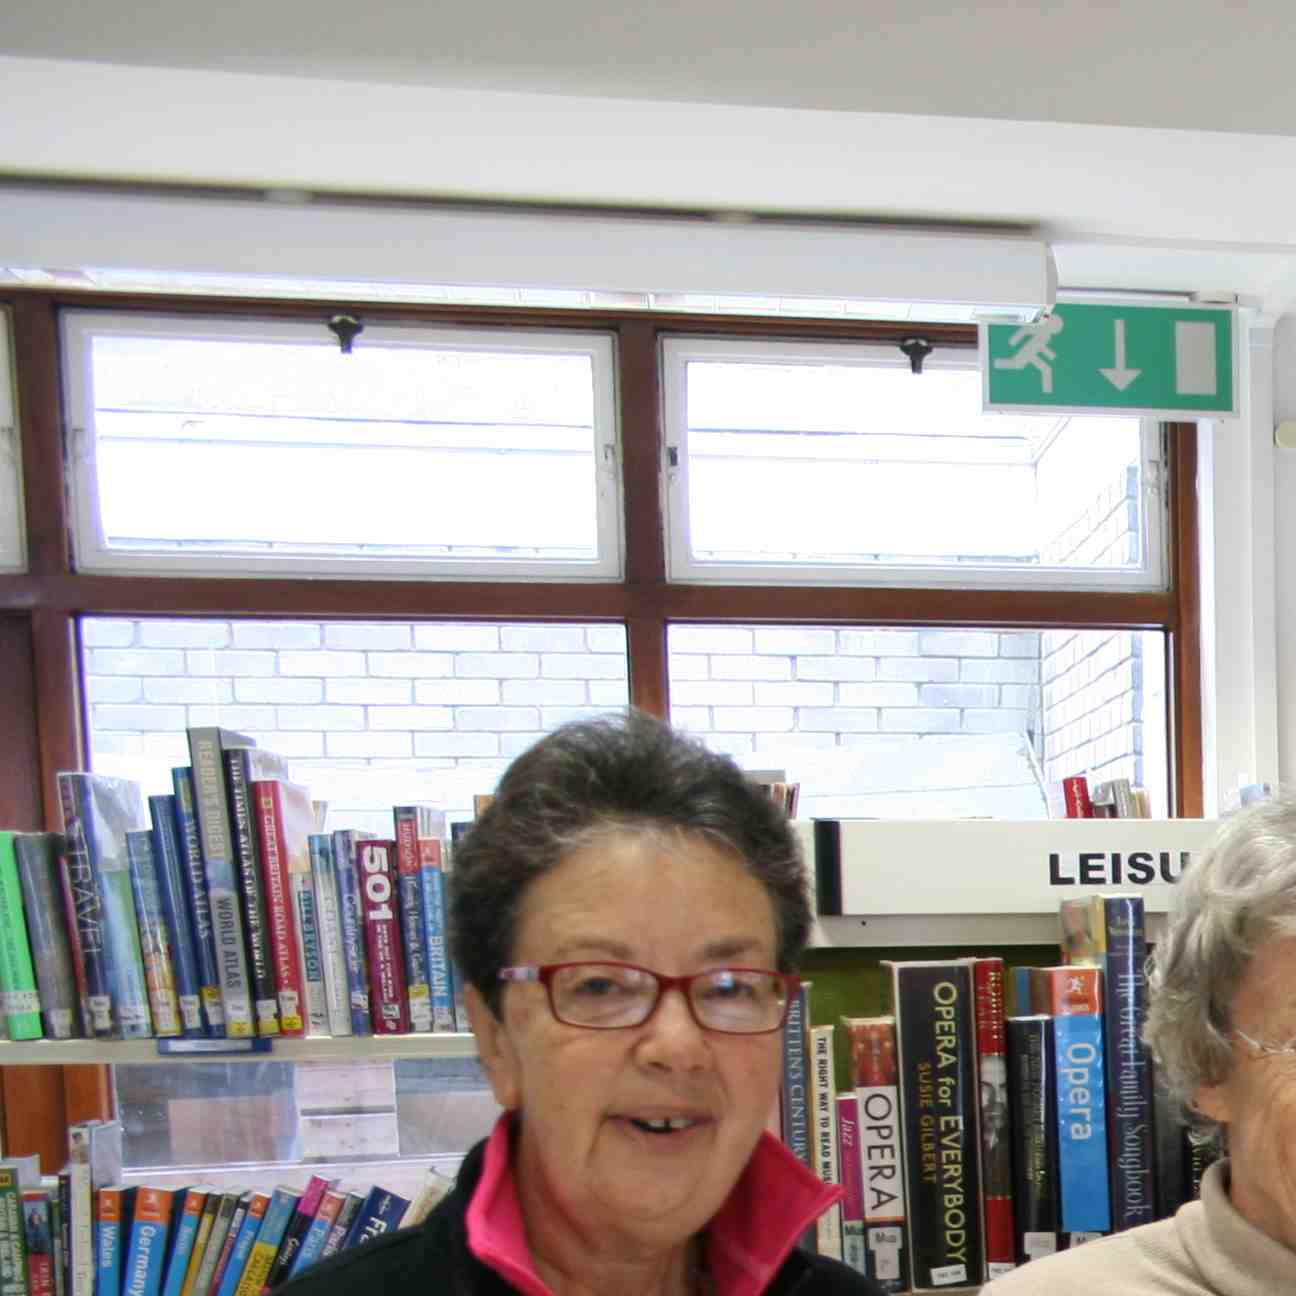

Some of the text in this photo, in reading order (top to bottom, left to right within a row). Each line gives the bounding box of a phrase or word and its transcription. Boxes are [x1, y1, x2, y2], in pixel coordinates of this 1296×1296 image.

[363, 845, 394, 922] 501
[1049, 852, 1190, 885] LEISU
[215, 896, 241, 989] WORLD ATLAS
[428, 935, 447, 998] BRITAIN
[816, 1037, 828, 1055] THE
[933, 981, 961, 1069] OPERA
[817, 1058, 829, 1088] RIGHT
[938, 1076, 955, 1108] for
[1061, 1042, 1097, 1141] Opera
[819, 1092, 830, 1112] WAY
[820, 1117, 831, 1129] TO
[917, 1062, 938, 1185] SUSIE GILBERT
[821, 1132, 832, 1158] READ
[841, 1117, 856, 1148] Jazz
[865, 1094, 898, 1211] OPERA
[938, 1114, 967, 1264] EVERYBODY
[1119, 1122, 1152, 1218] Songbook
[102, 1226, 117, 1268] Wales
